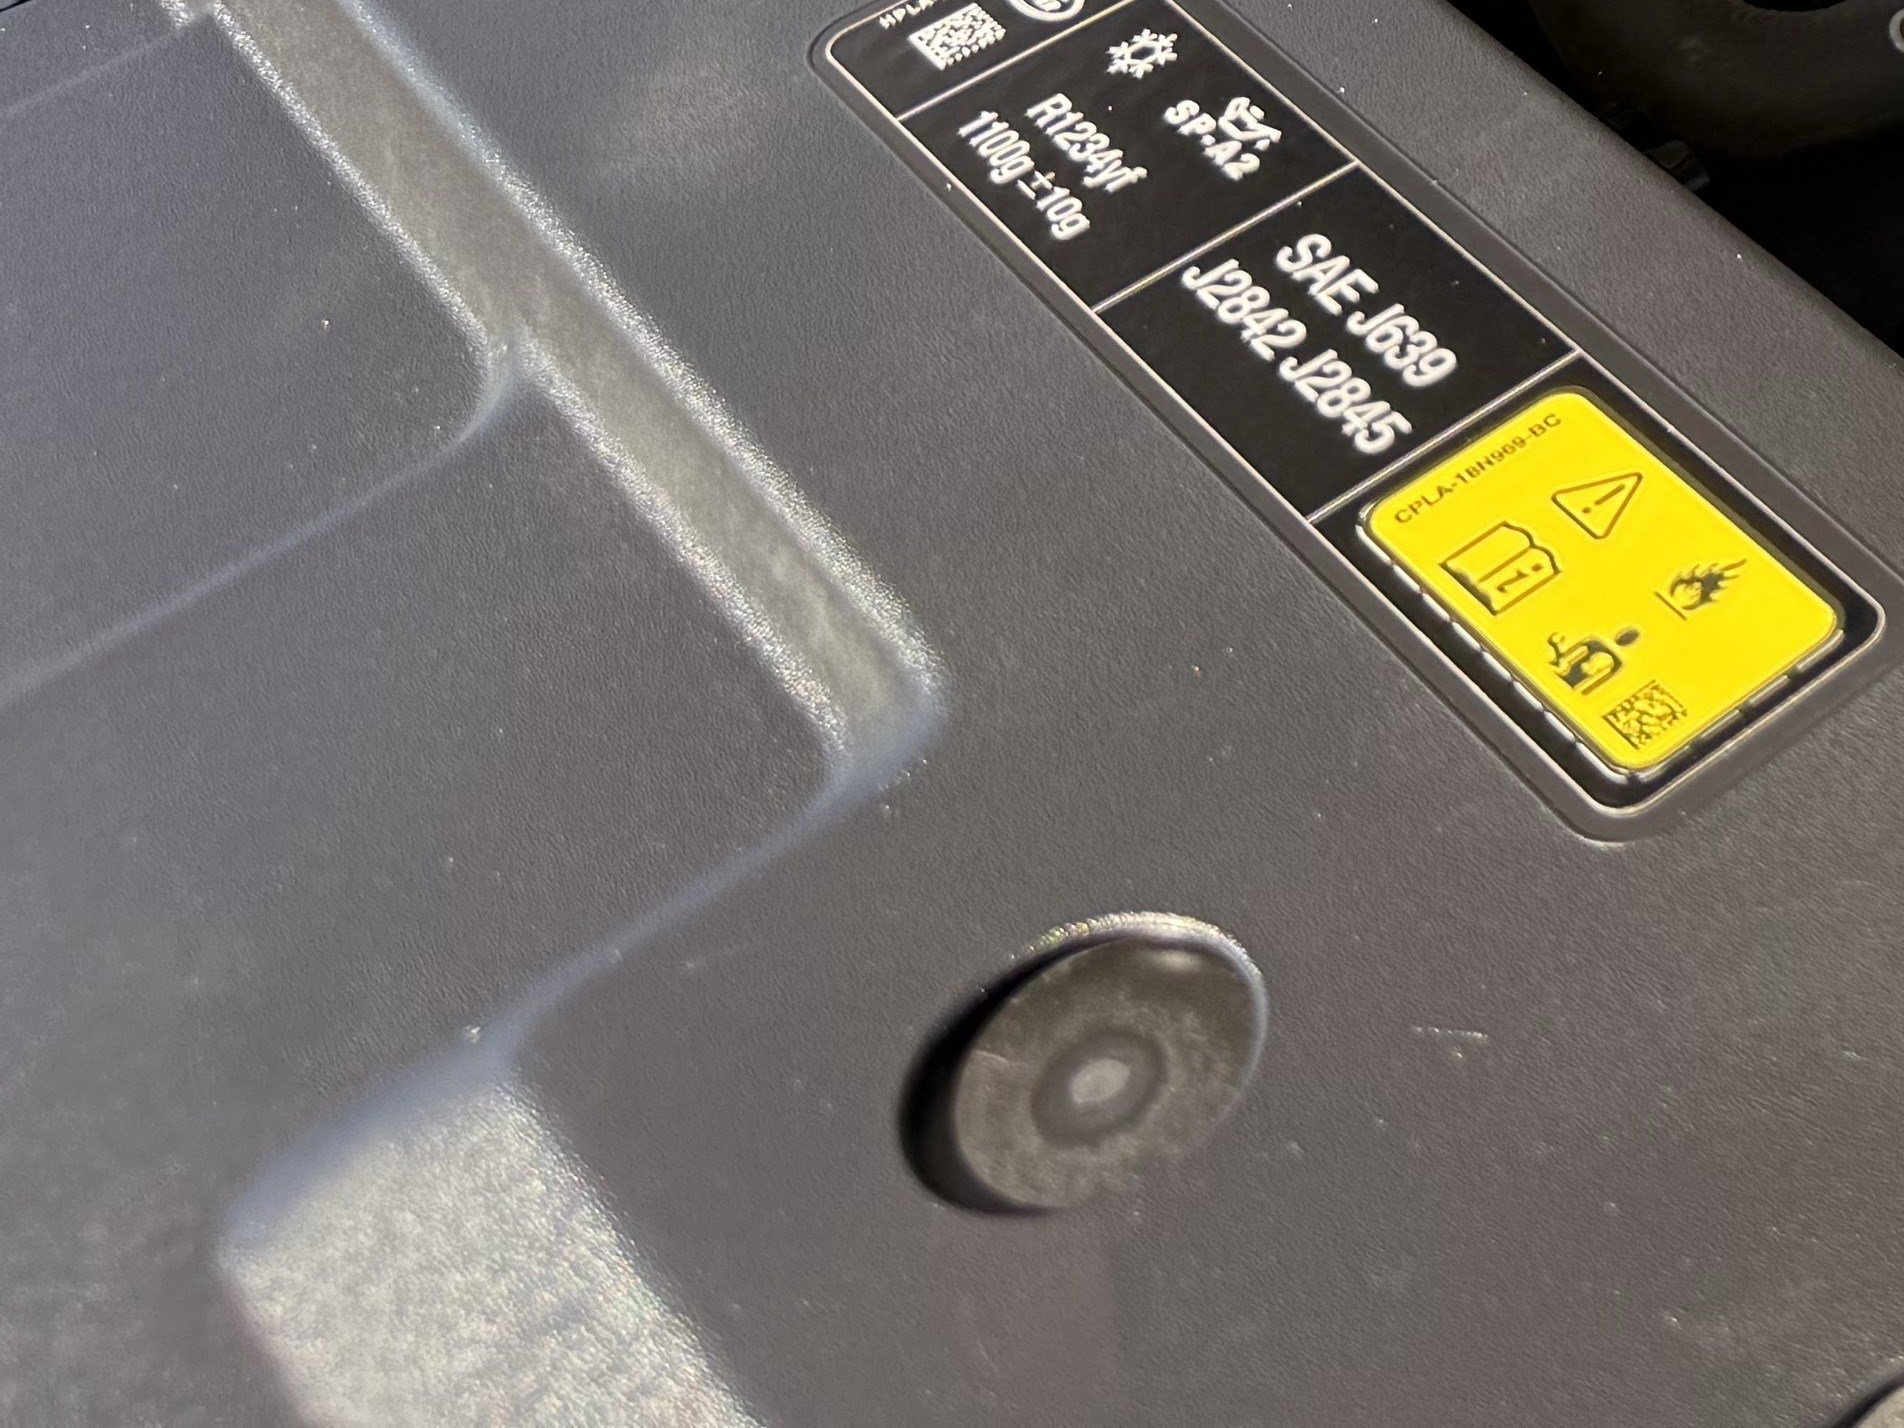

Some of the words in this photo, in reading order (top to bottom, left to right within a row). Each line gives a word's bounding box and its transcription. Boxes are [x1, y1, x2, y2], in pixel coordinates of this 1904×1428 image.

[1024, 93, 1148, 193] R1234yf
[1163, 99, 1261, 181] SP-A2
[1180, 258, 1308, 362] J2842
[1278, 348, 1414, 455] J2845
[1275, 233, 1379, 316] SAE
[1346, 303, 1459, 388] J639
